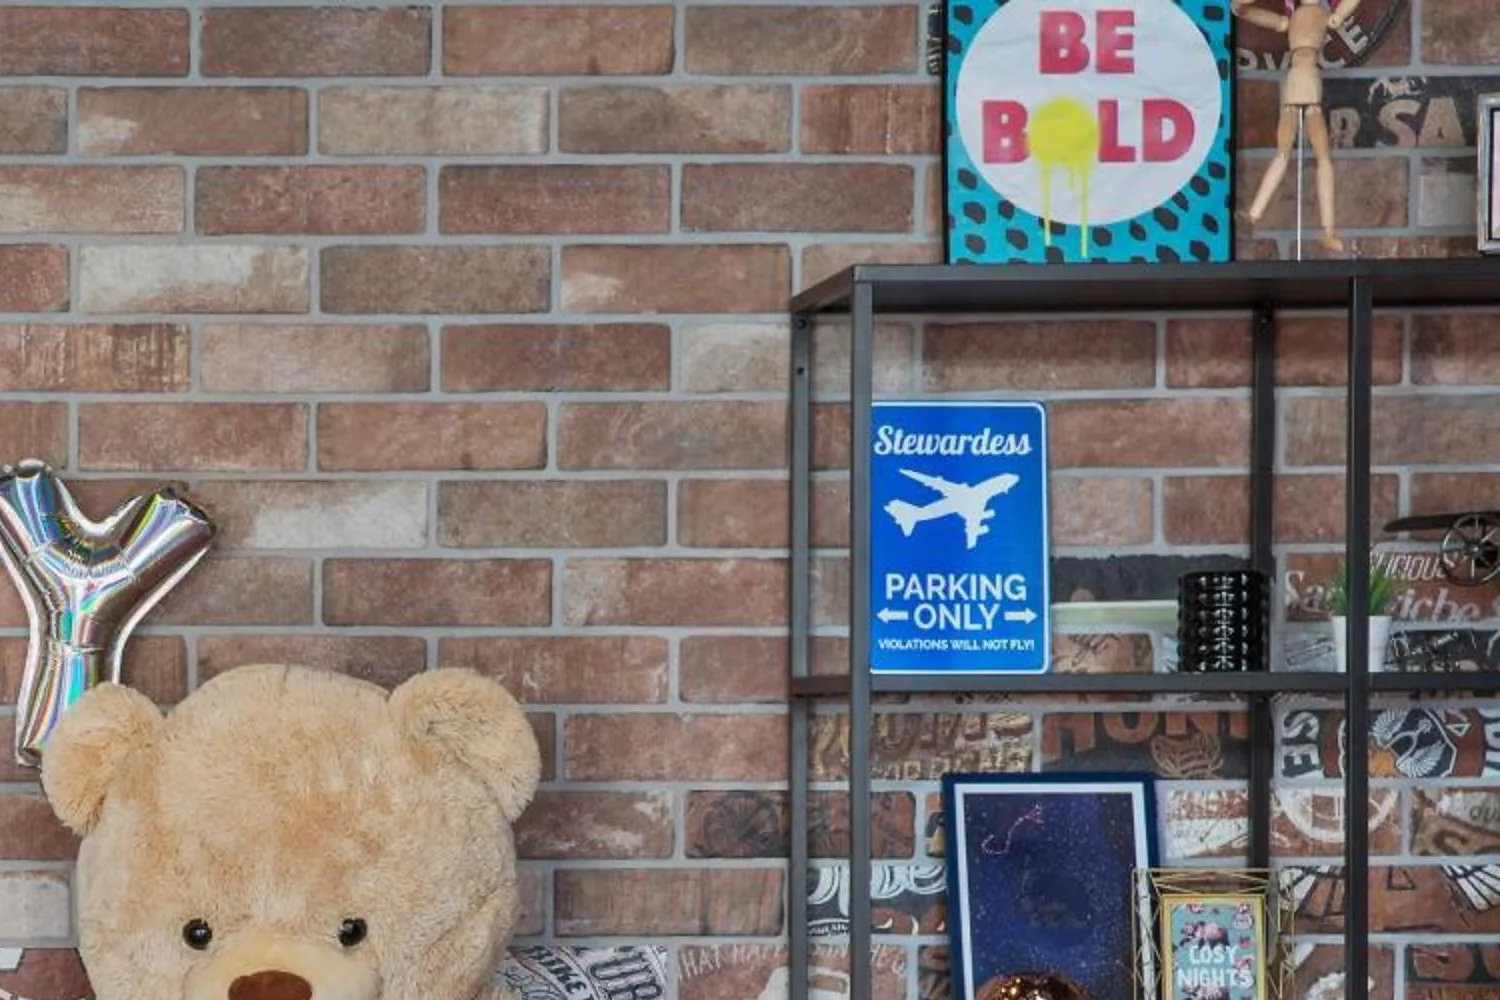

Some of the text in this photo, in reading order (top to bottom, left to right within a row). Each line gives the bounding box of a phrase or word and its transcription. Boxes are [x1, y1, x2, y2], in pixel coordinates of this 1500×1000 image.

[1040, 10, 1135, 74] BE
[874, 425, 1032, 455] Stewardess
[885, 573, 1027, 601] PARKING
[913, 603, 1001, 631] ONLY
[878, 639, 1035, 651] VIOLATIONS WILL NOT FLY!
[1189, 945, 1237, 966] COSY
[1176, 966, 1255, 989] NIGHTS
